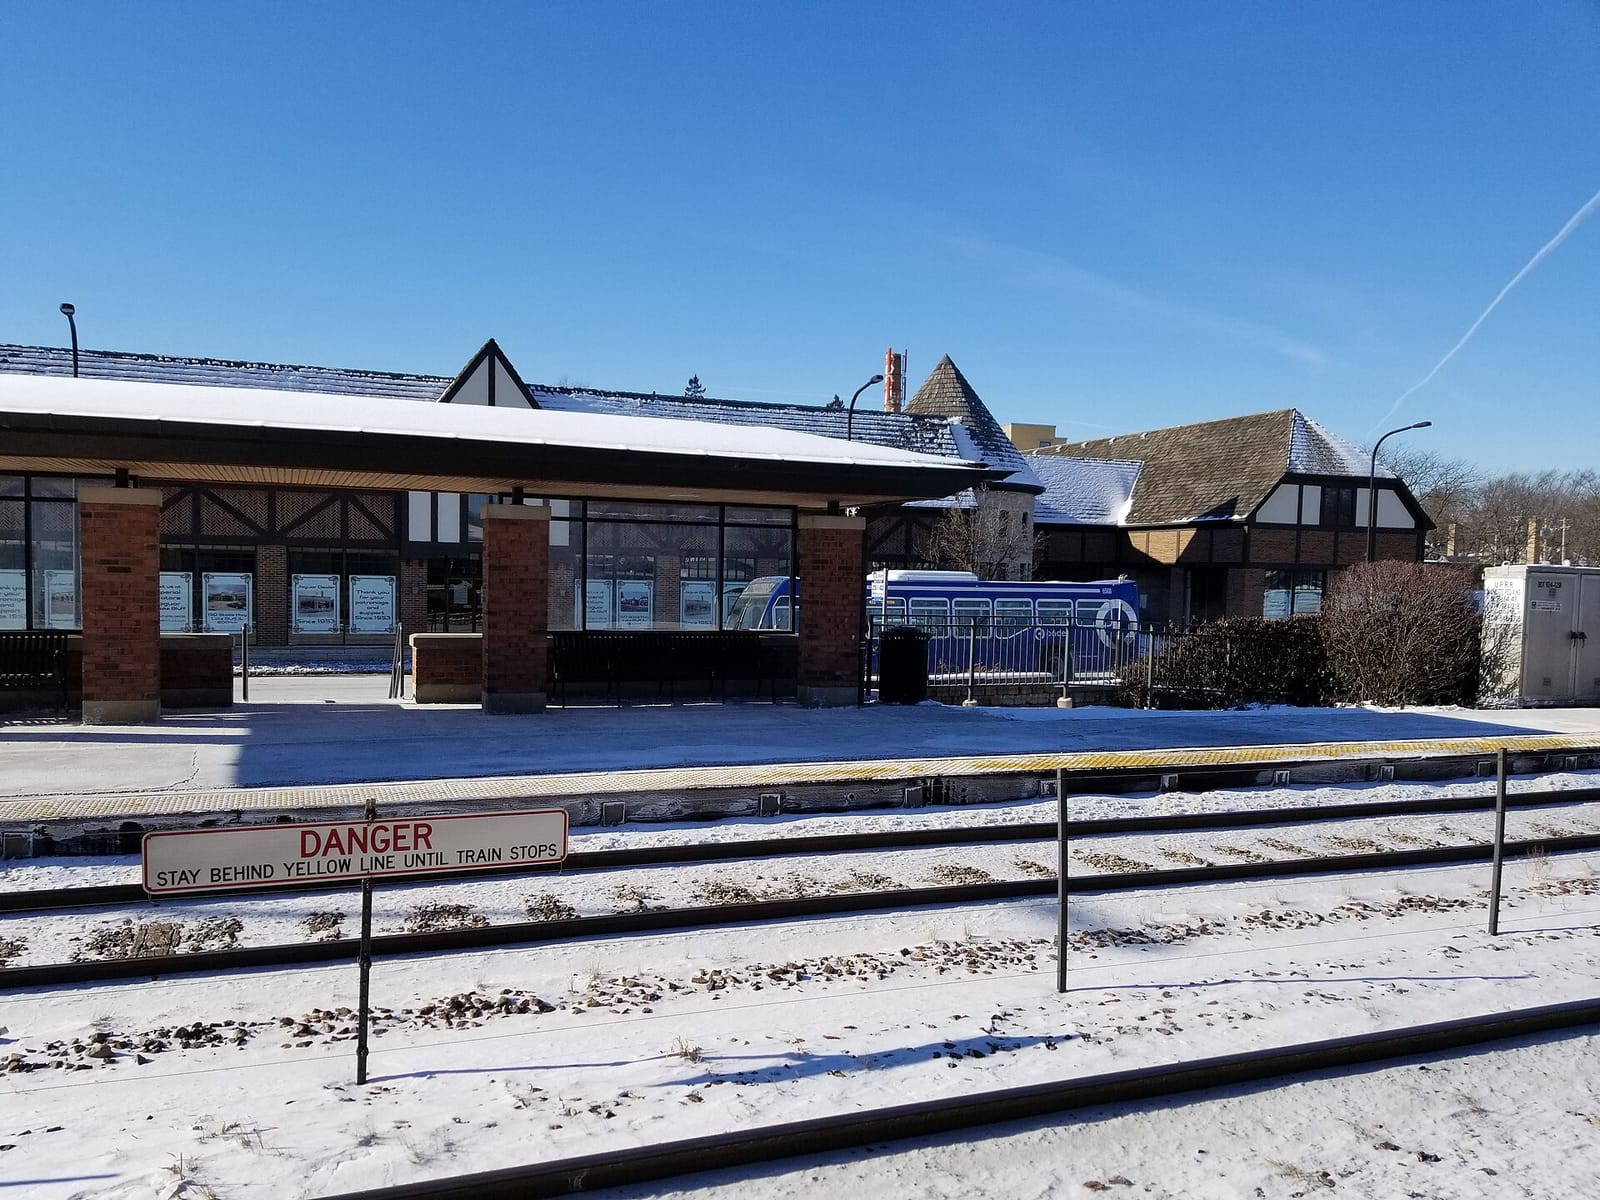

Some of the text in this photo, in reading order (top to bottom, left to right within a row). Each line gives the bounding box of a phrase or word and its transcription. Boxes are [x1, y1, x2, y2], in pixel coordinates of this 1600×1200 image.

[300, 823, 433, 858] DANGER
[156, 843, 557, 887] STAY BEHIND YELLOW LINE UNTIL TRAIN STOPS
